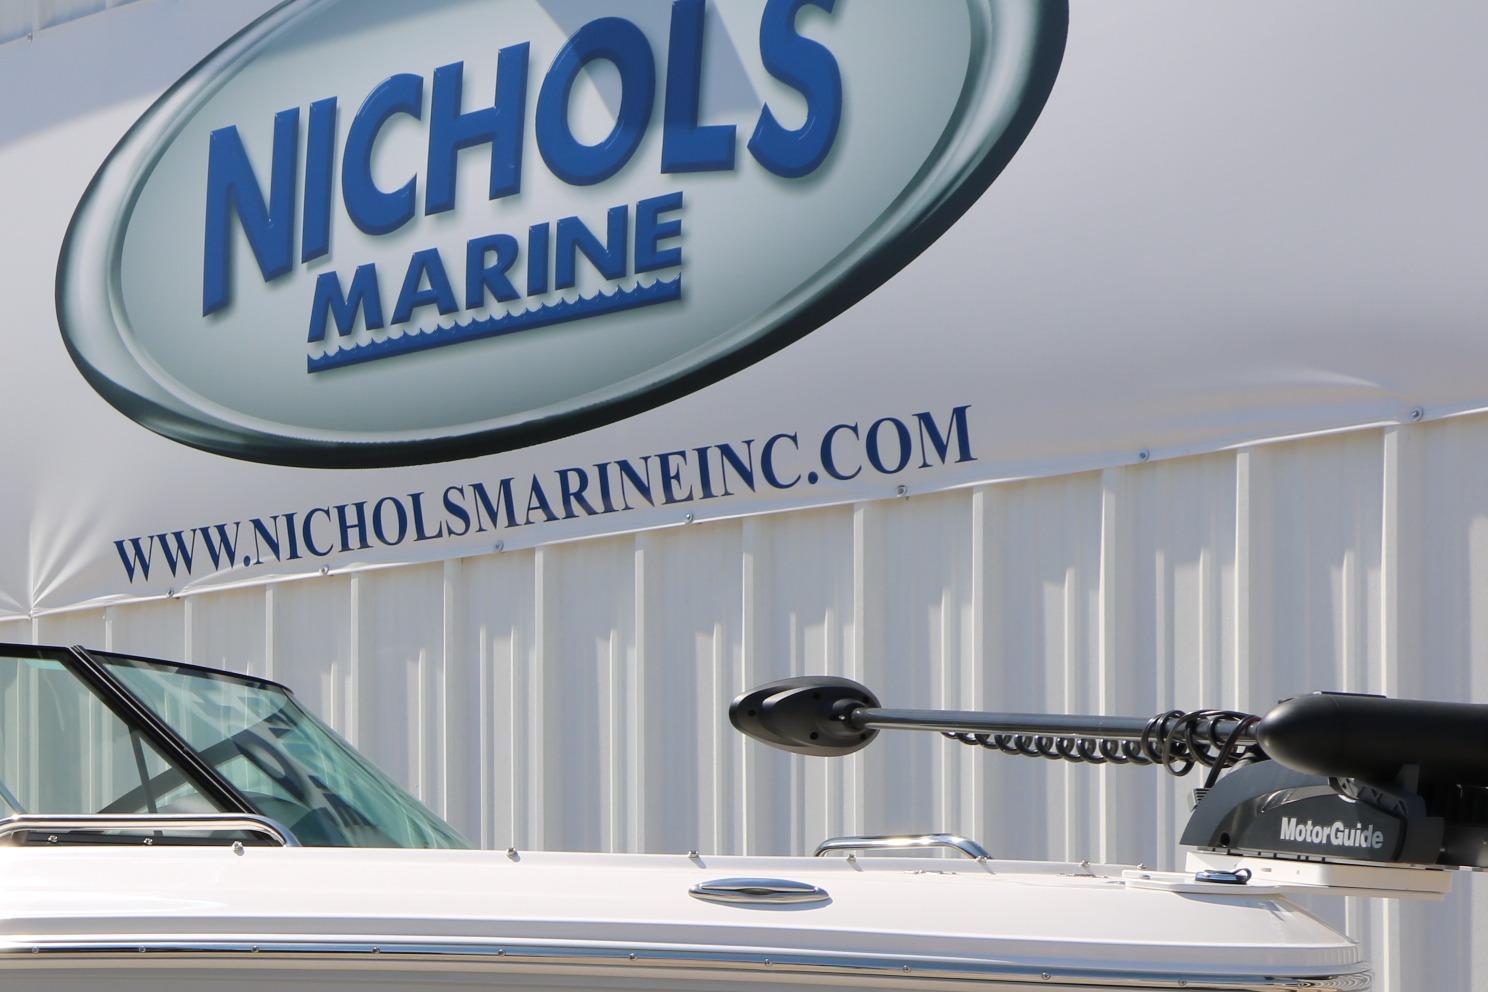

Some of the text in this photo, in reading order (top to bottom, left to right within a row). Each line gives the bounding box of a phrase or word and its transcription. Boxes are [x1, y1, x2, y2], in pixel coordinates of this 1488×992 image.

[202, 0, 843, 316] NICHOLS
[307, 191, 683, 342] MARINE
[114, 404, 977, 583] WWW.NICHOLSMARINEINC.COM
[1280, 817, 1383, 849] MotorGuide
